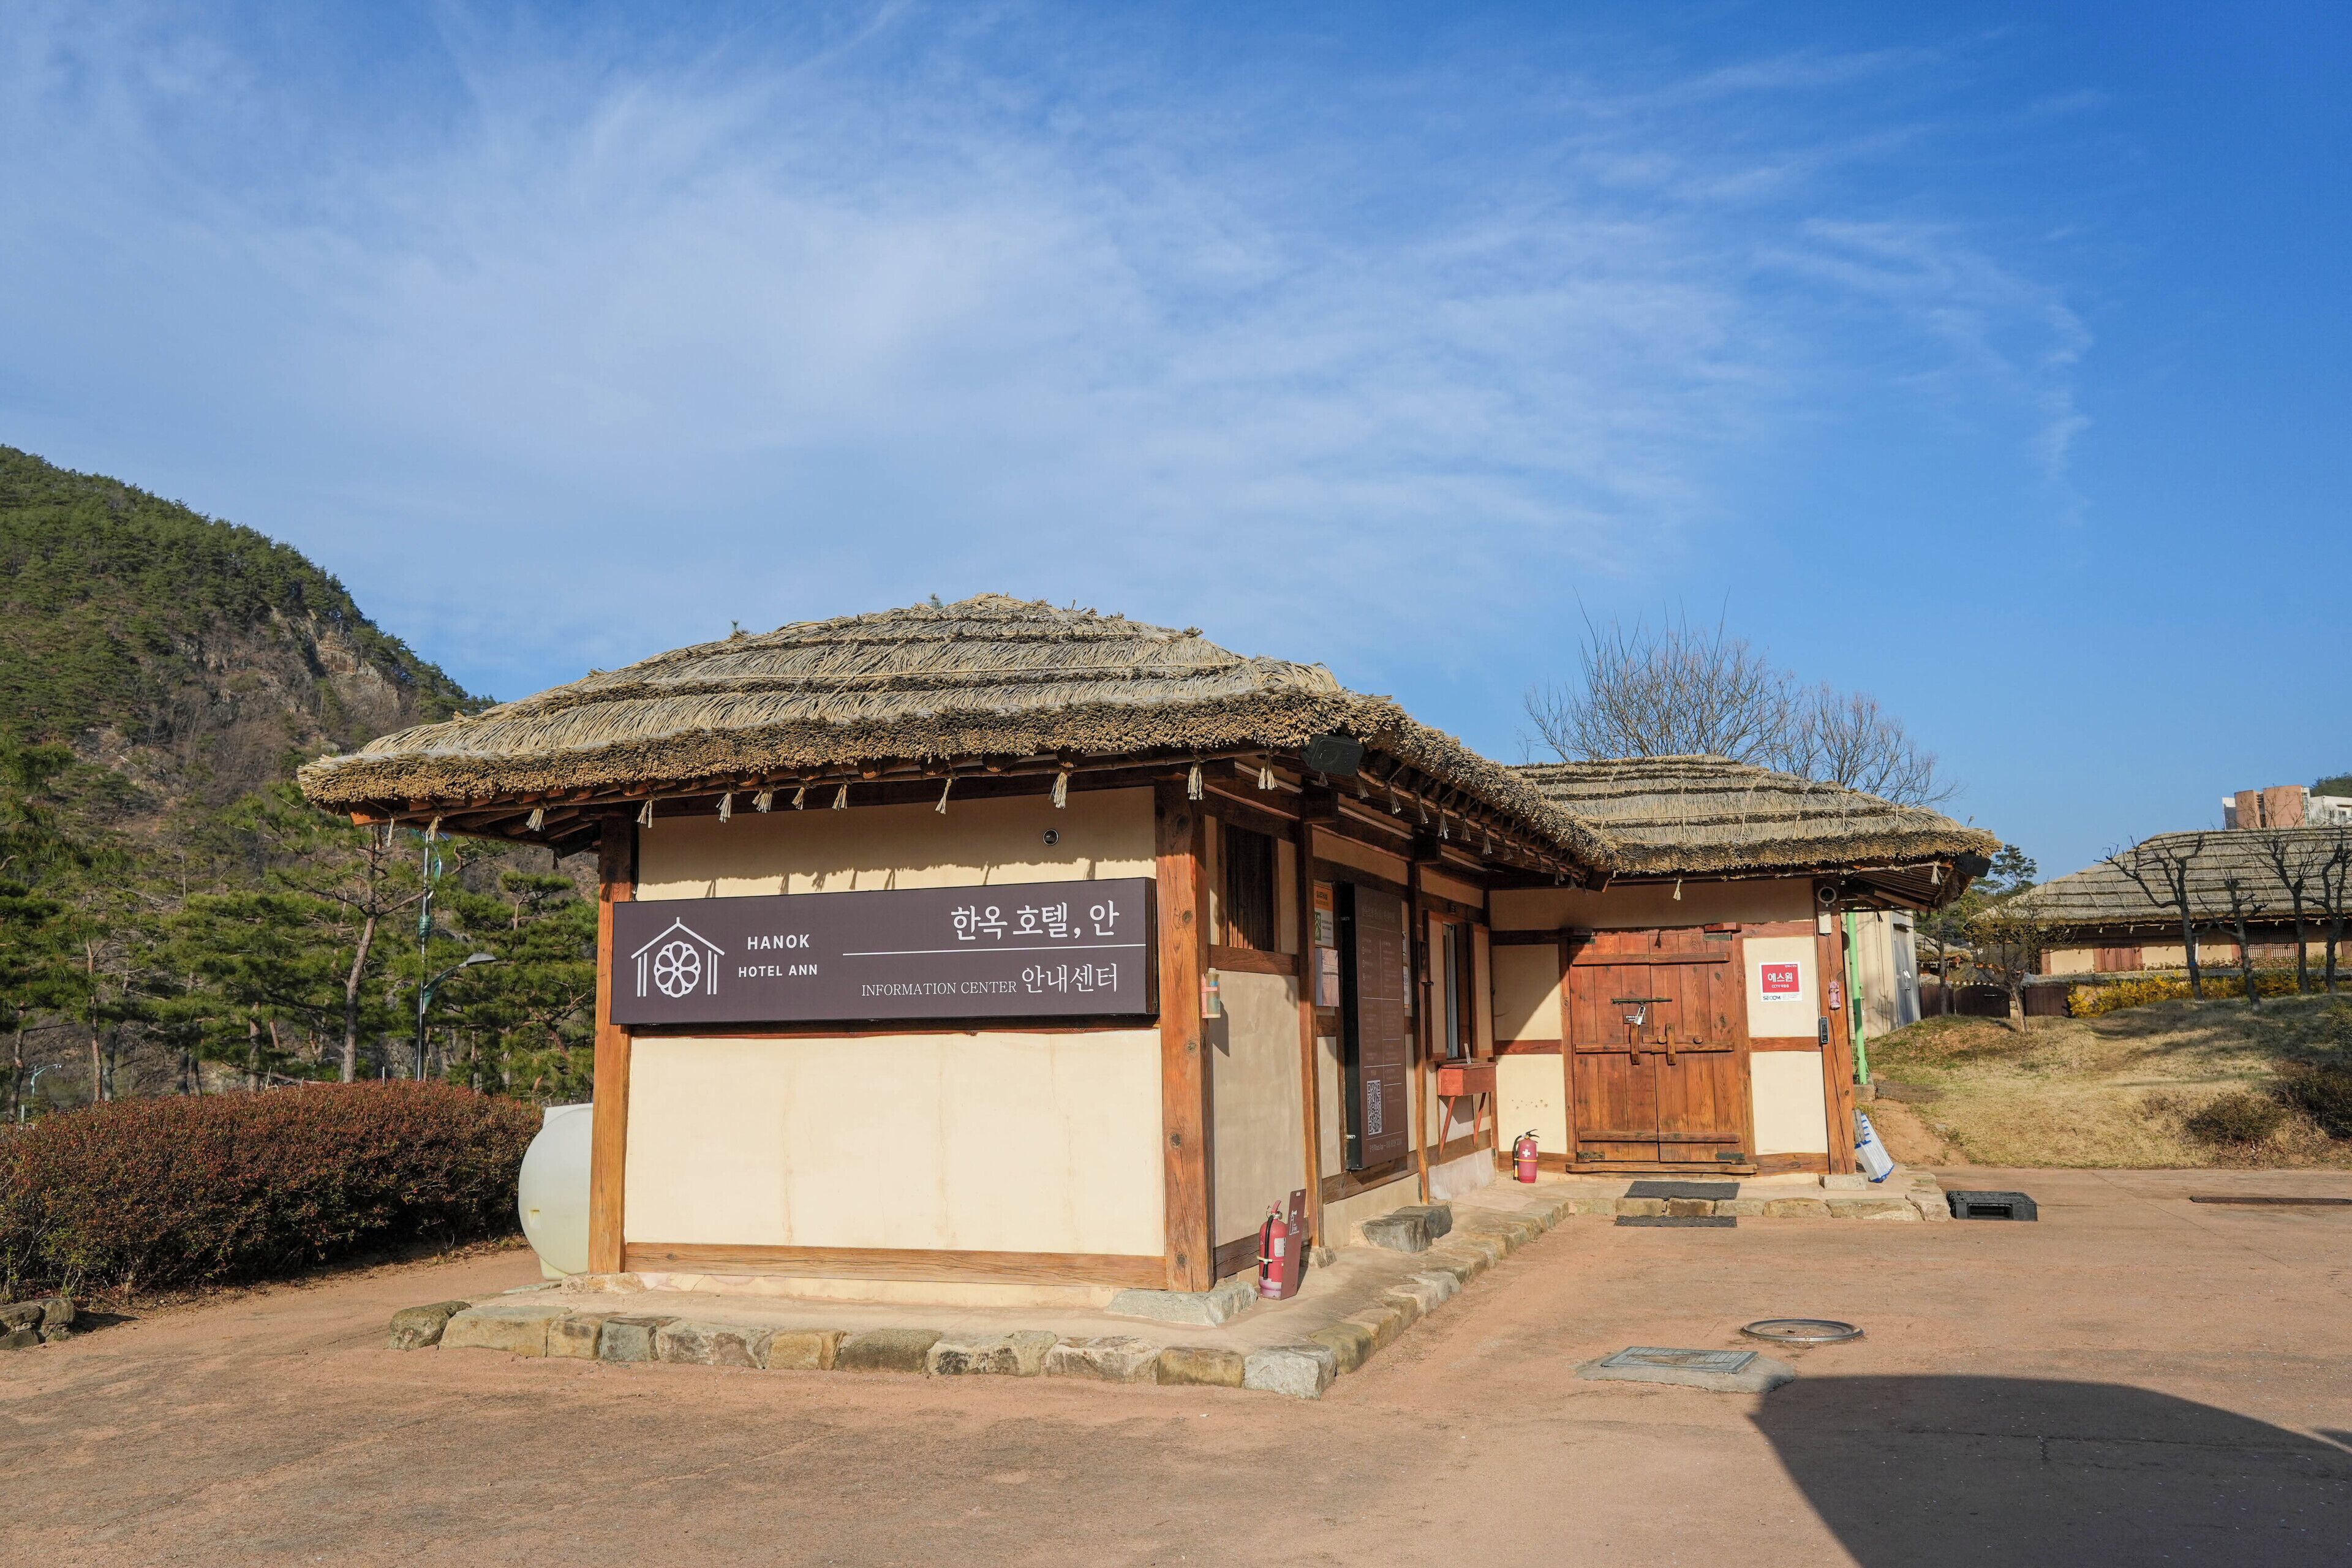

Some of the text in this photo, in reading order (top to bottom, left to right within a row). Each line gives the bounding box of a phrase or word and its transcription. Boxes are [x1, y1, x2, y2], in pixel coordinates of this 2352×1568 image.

[951, 900, 1120, 940] 한옥 호텔, 안
[747, 933, 810, 950] HANOK
[738, 964, 818, 978] HOTEL ANN
[1768, 972, 1793, 982] 에스원
[862, 963, 1117, 997] INFORMATION CENTER 안내센터
